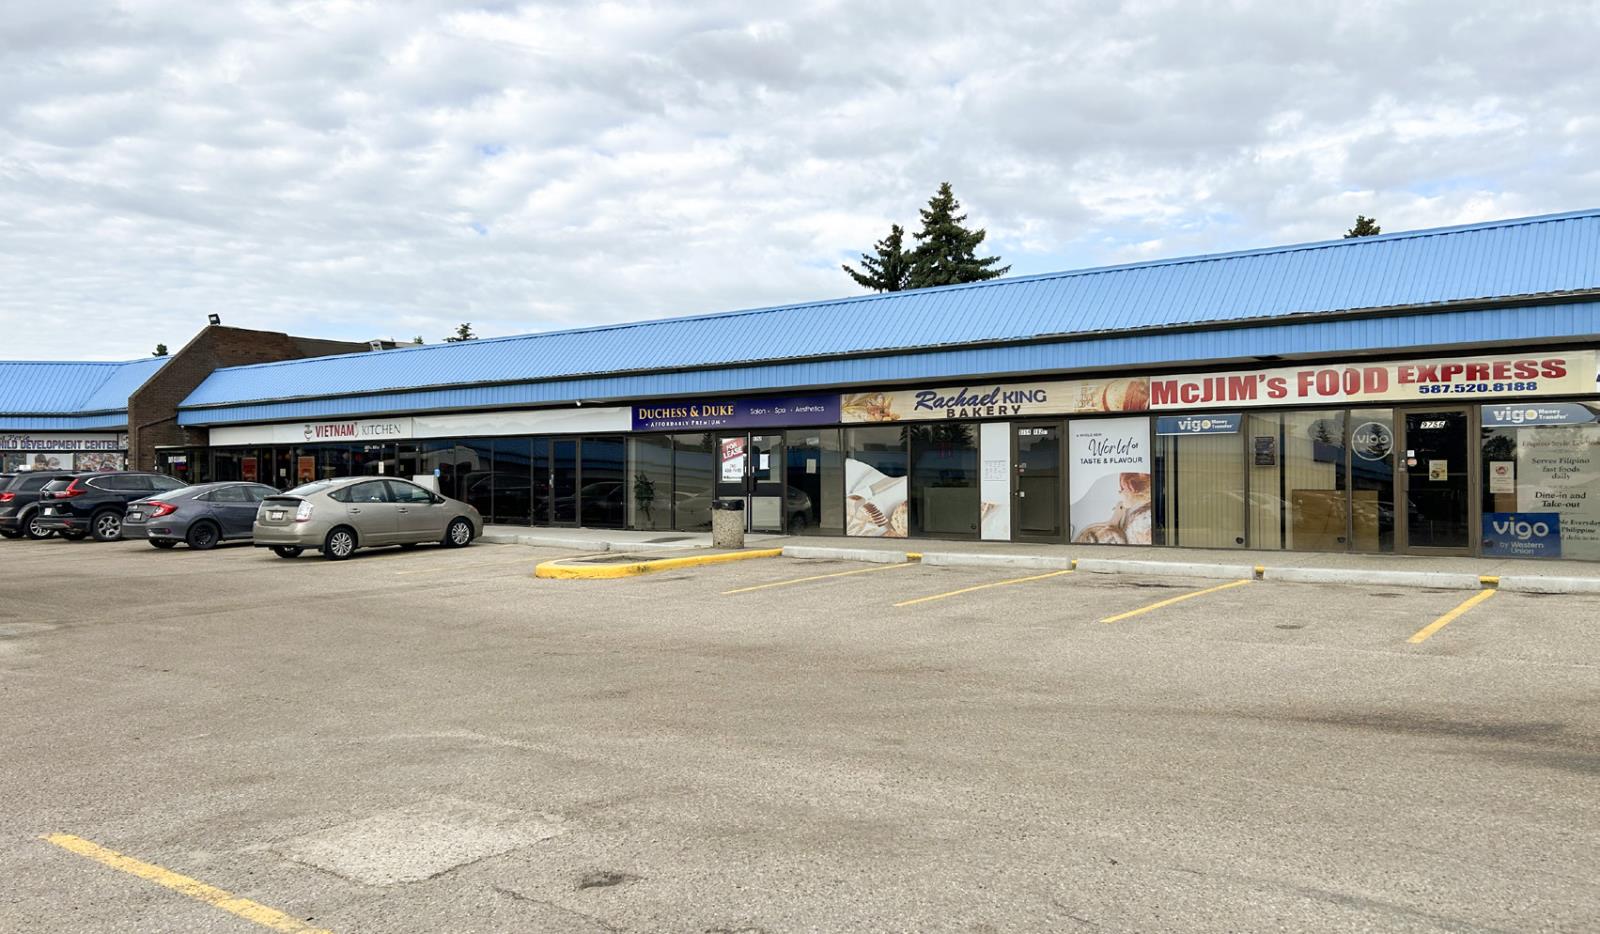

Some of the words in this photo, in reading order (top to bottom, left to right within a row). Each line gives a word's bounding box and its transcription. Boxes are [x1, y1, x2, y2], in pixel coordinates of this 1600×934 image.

[1151, 374, 1288, 405] McJIM's
[1297, 367, 1389, 397] FOOD
[1397, 358, 1567, 385] EXPRESS
[1419, 381, 1538, 394] 587.520.8188
[914, 386, 1000, 411] Rachael
[1003, 390, 1047, 404] KING
[639, 407, 687, 420] DUCHESS
[690, 405, 699, 417] &
[702, 405, 734, 417] DUKE
[774, 406, 786, 415] Spa
[946, 405, 1021, 418] BAKERY
[1493, 407, 1538, 423] vigo
[315, 424, 355, 438] VIETNAM
[361, 424, 401, 435] KITCHEN
[1178, 417, 1211, 432] vigo
[20, 440, 82, 449] DEVELOPMENT
[84, 440, 118, 449] CENTER
[1088, 436, 1133, 456] World
[1110, 456, 1143, 464] FLAVOUR
[1535, 491, 1568, 499] Dine-in
[1569, 491, 1586, 499] and
[1542, 500, 1580, 508] Take-out
[1492, 516, 1550, 540] vigo
